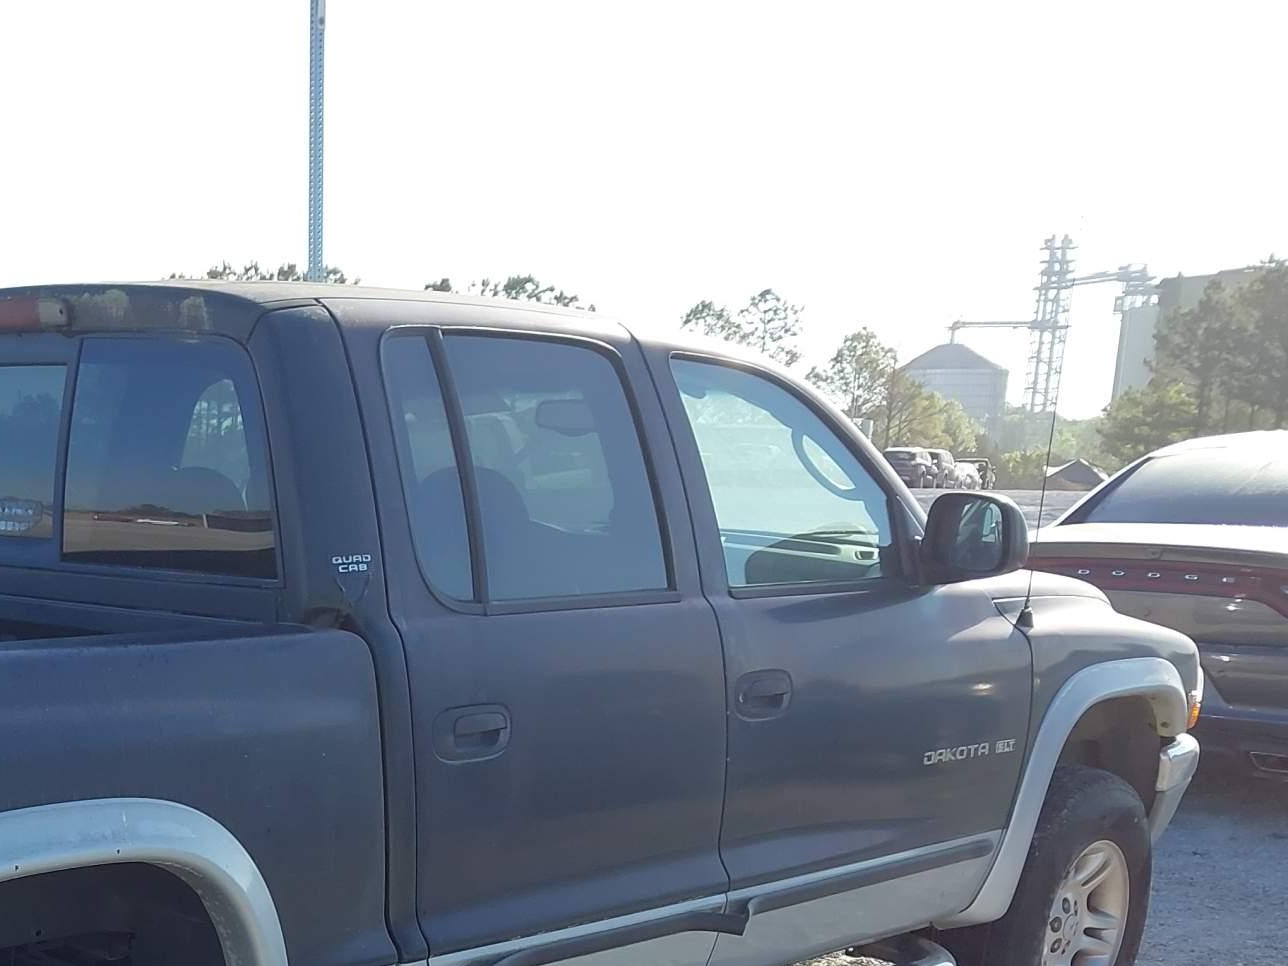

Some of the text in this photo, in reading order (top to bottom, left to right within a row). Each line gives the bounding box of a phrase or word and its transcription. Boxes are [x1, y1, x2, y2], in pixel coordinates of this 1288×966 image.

[332, 554, 371, 564] QUAD
[338, 563, 368, 573] CAB
[923, 742, 990, 765] DAKOTA
